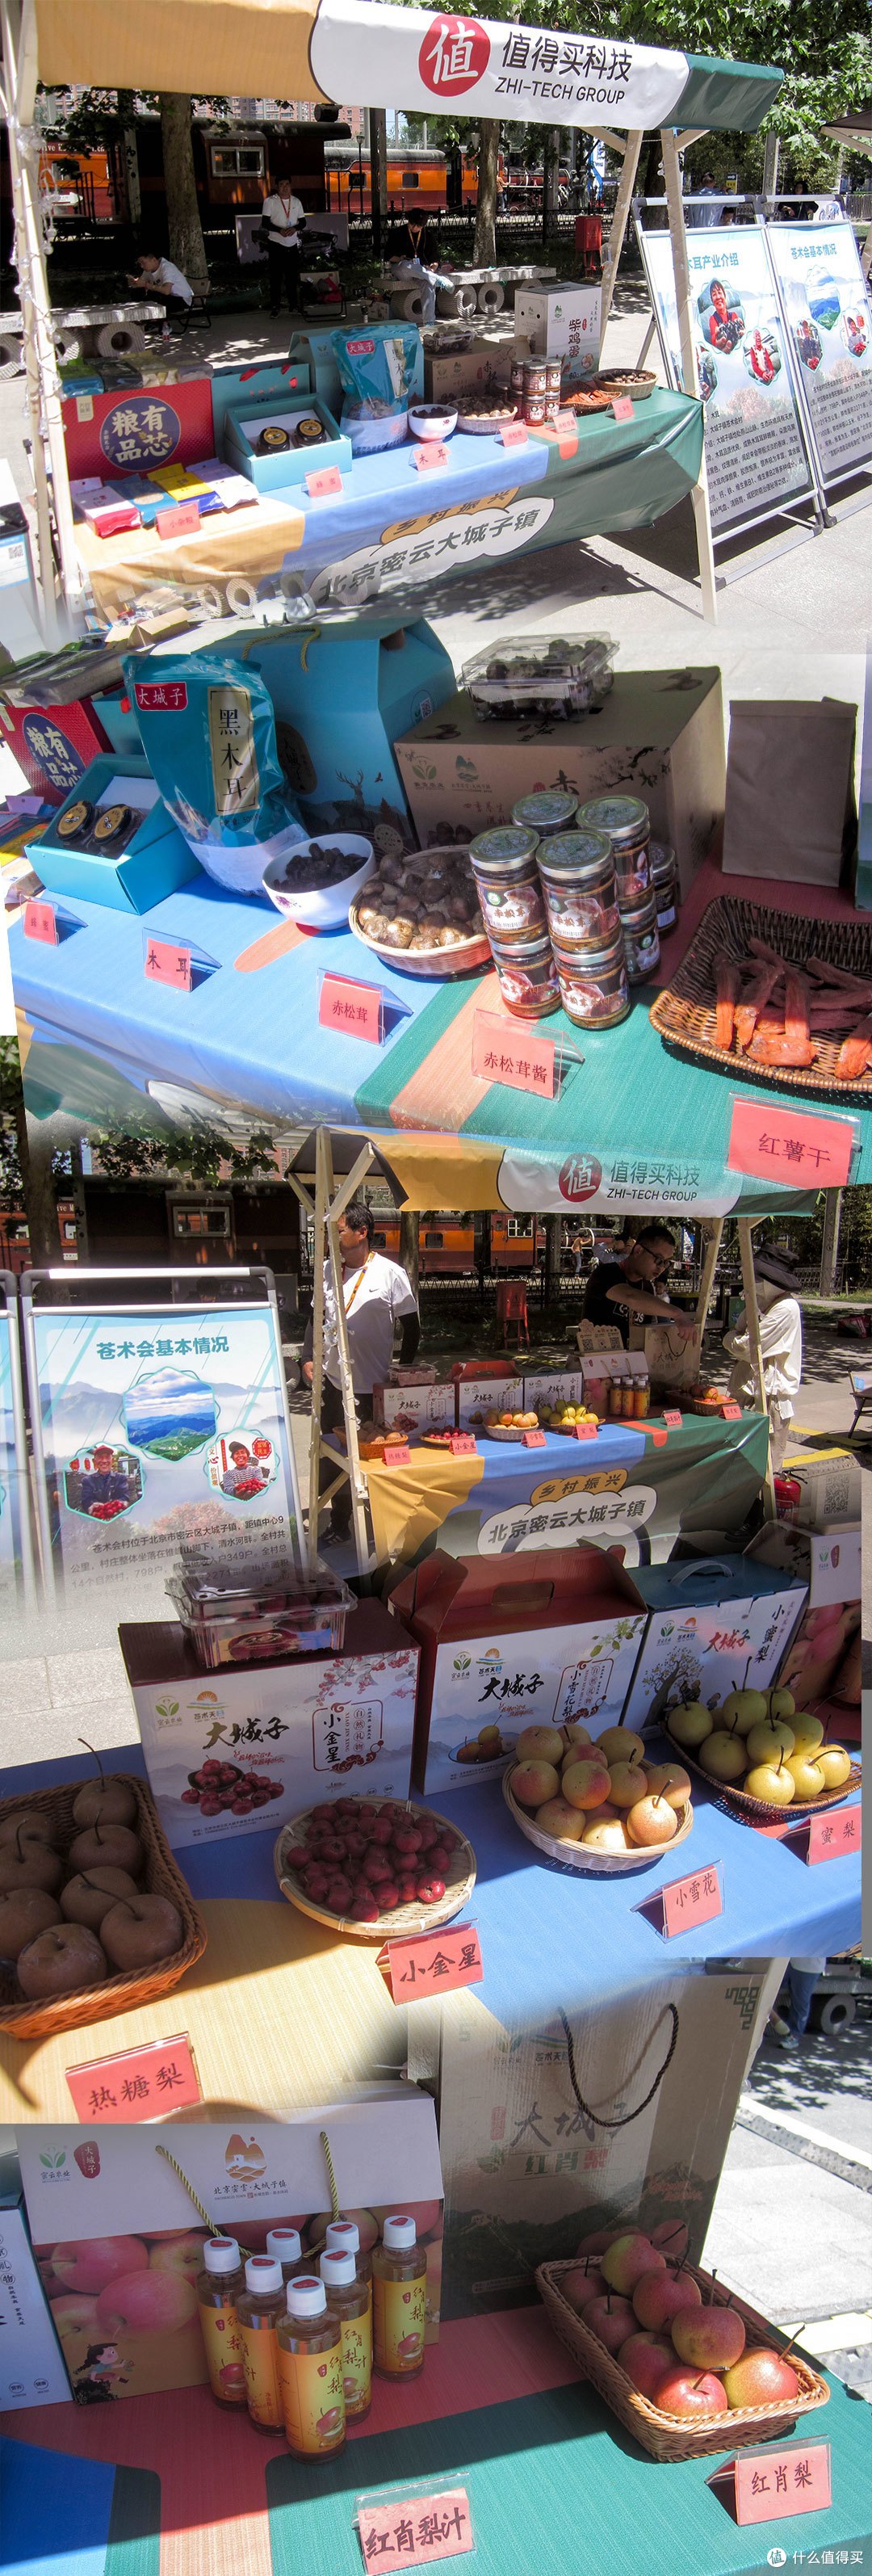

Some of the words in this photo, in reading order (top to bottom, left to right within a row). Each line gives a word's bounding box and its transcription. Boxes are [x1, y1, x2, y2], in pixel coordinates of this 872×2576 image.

[431, 21, 480, 84] 值
[501, 32, 634, 82] 值得买科技
[494, 77, 574, 101] ZHI-TECH
[575, 85, 626, 106] GROUP
[790, 243, 837, 259] 苍术会基本情况
[568, 318, 581, 358] 柴鸡蛋
[419, 448, 445, 464] 木耳
[393, 490, 510, 536] 乡村振兴
[319, 509, 541, 602] 北京密云大城子镇
[139, 687, 183, 706] 大城子
[218, 708, 247, 799] 黑木耳
[148, 950, 188, 981] 木耳
[332, 1000, 368, 1023] 赤松茸
[483, 1052, 548, 1084] 赤松茸酱
[757, 1132, 833, 1168] 红薯干
[564, 1157, 597, 1196] 值
[610, 1160, 701, 1187] 值得买科技
[606, 1188, 659, 1200] ZHI-TECH
[661, 1191, 698, 1201] GROUP
[95, 1335, 229, 1360] 苍术会基本情况
[455, 1442, 476, 1451] 小金星
[539, 1473, 622, 1498] 乡村振兴
[488, 1500, 647, 1544] 北京密云大城子镇
[702, 1628, 751, 1654] 大城子
[755, 1604, 785, 1664] 小蜜梨
[478, 1674, 544, 1702] 大城子
[203, 1717, 289, 1750] 大城子
[324, 1713, 342, 1763] 小金星
[820, 1822, 855, 1845] 蜜梨
[675, 1873, 716, 1909] 小雪花
[400, 1943, 480, 1981] 小金星
[87, 2062, 186, 2116] 热糖梨
[510, 2101, 631, 2148] 大城子
[85, 2146, 96, 2174] 大城子
[751, 2460, 812, 2497] 红肖梨
[365, 2507, 466, 2561] 红肖梨汁
